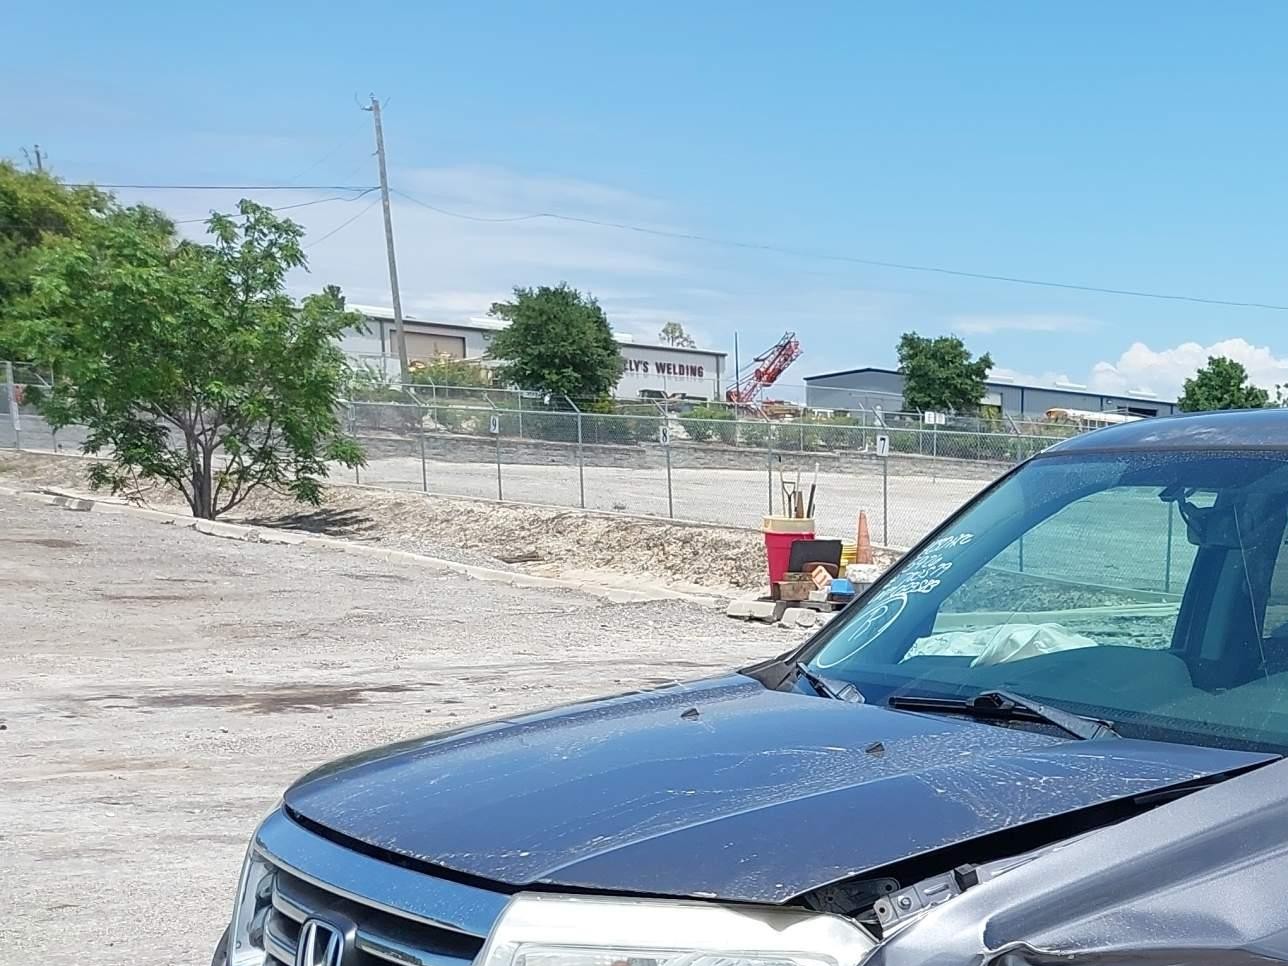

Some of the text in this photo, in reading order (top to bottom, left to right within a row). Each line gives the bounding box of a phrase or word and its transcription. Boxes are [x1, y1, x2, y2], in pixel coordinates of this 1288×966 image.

[655, 361, 704, 378] WELDING
[491, 417, 498, 432] 9
[662, 428, 668, 443] 8
[880, 437, 886, 455] 7
